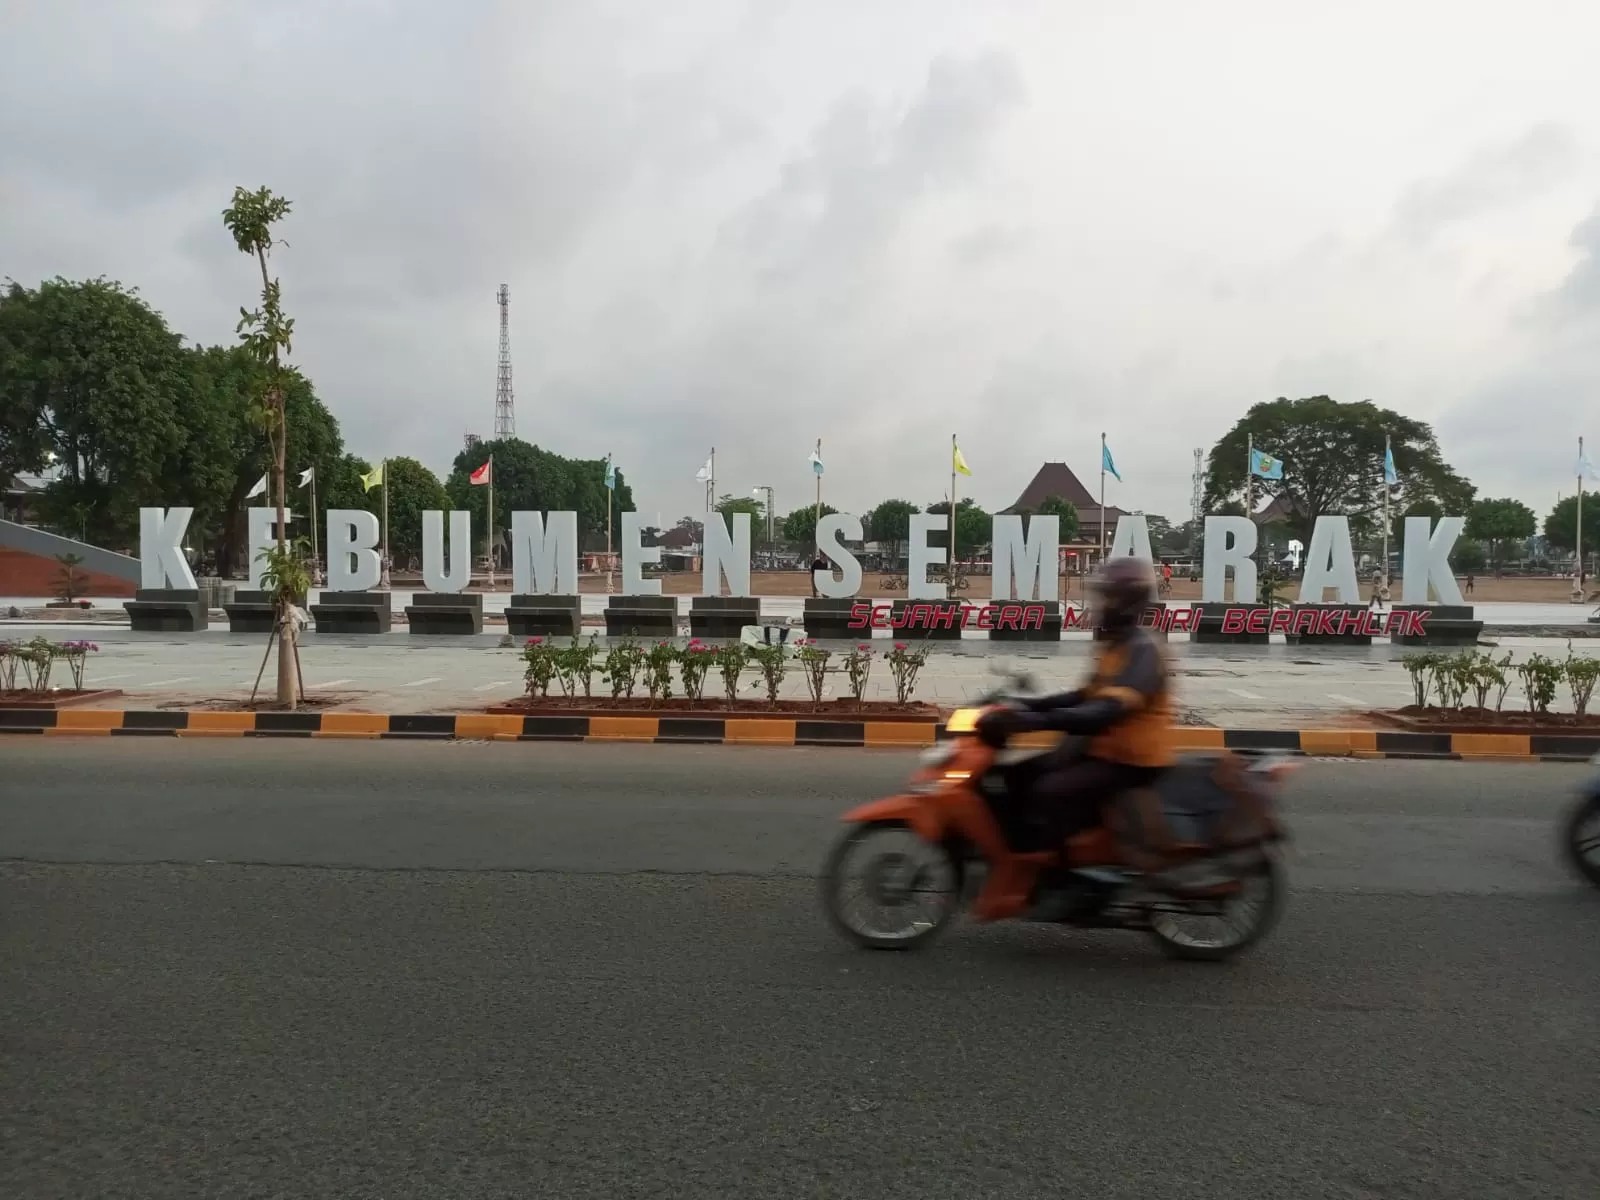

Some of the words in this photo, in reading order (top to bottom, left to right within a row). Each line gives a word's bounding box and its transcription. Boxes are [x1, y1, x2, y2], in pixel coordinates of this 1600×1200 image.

[139, 506, 752, 598] KEBUMEN
[848, 604, 1046, 630] SEJAHTERA
[1062, 606, 1204, 633] MDIRI
[1221, 608, 1433, 636] BERAKHLAK
